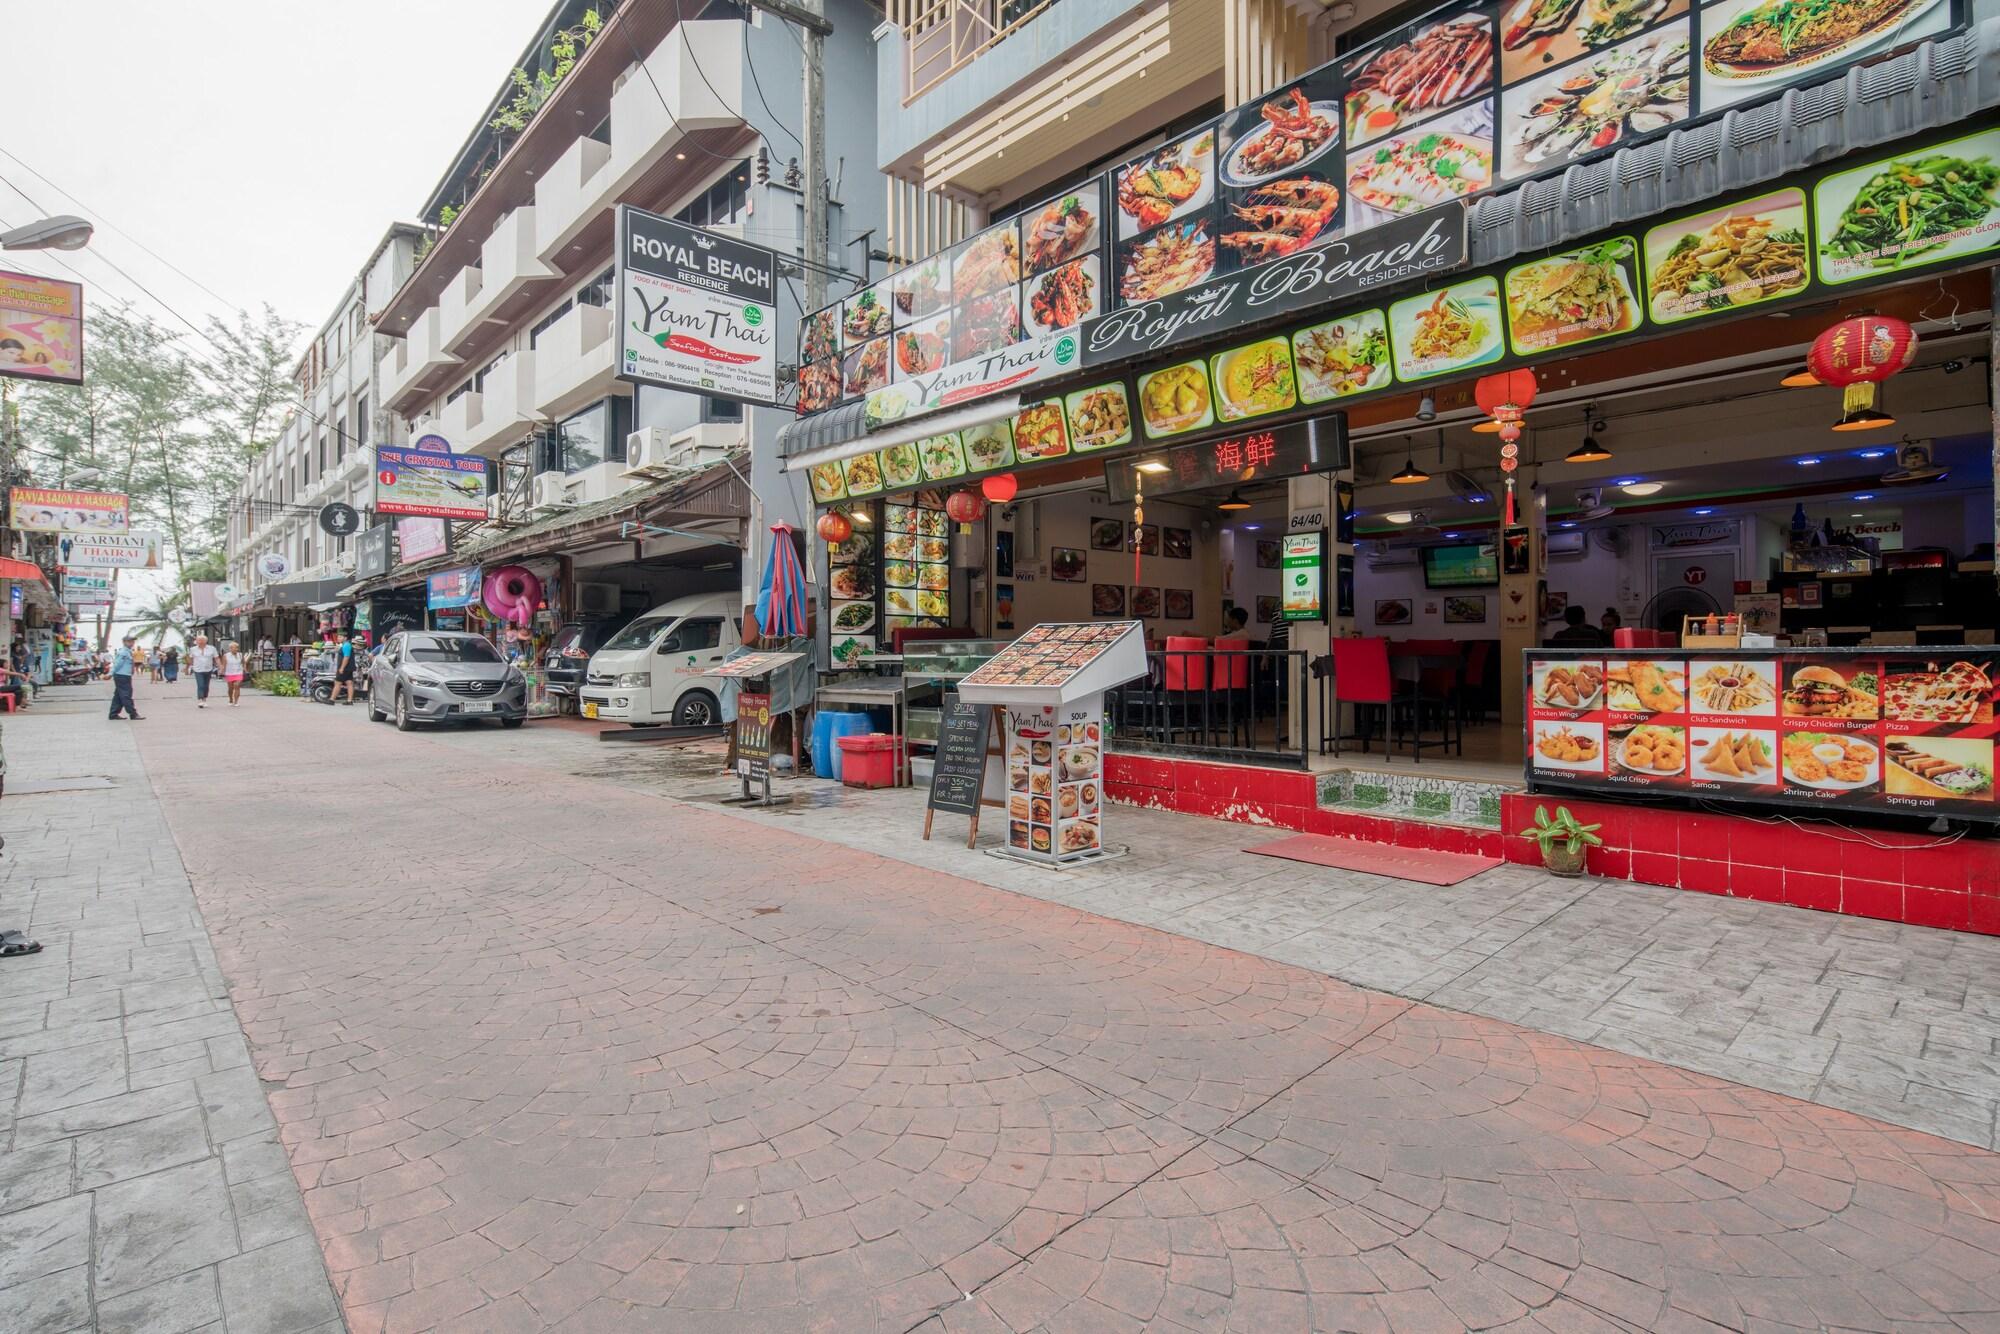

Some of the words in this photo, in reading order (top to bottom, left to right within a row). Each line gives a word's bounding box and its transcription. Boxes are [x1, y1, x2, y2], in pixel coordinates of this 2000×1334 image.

[1903, 238, 1927, 250] FRIED
[1930, 229, 1972, 244] MORNING
[632, 233, 700, 270] ROYAL
[707, 255, 770, 289] BEACH
[1358, 254, 1445, 287] RESIDENCE
[678, 271, 729, 292] RESIDENCE
[1088, 283, 1239, 350] Royal
[1247, 216, 1451, 305] Beach
[669, 338, 706, 354] Seafood
[639, 354, 659, 365] Mobile
[704, 368, 732, 379] Reception
[668, 375, 700, 386] Restaurant
[744, 389, 772, 400] Restaurant
[1216, 432, 1275, 473] 海鲜
[405, 454, 454, 469] CRYSTAL
[456, 460, 484, 472] TOUR
[379, 503, 485, 517] www.thecrystaltour.com
[1291, 513, 1322, 528] 64/40
[1854, 521, 1902, 535] Beach
[74, 534, 144, 547] G.ARMANI
[1071, 712, 1087, 720] SOUP
[1533, 709, 1558, 718] Chicken
[1558, 710, 1579, 719] Wings
[1608, 712, 1622, 720] Fish
[1628, 713, 1649, 721] Chips
[1691, 715, 1708, 724] Club
[1709, 715, 1747, 725] Sandwich
[1783, 719, 1809, 729] Crispy
[1810, 719, 1845, 729] Chicken
[1846, 721, 1878, 731] Burger
[1886, 722, 1909, 731] Pizza
[1534, 768, 1556, 778] Shrimp
[1557, 770, 1577, 779] crispy
[1608, 774, 1628, 783] Squid
[1628, 776, 1650, 785] Crispy
[1691, 781, 1721, 790] Samosa
[1783, 787, 1814, 798] Shrimp
[1815, 790, 1837, 799] Cake
[1886, 795, 1918, 807] Spring
[1919, 797, 1935, 806] roll
